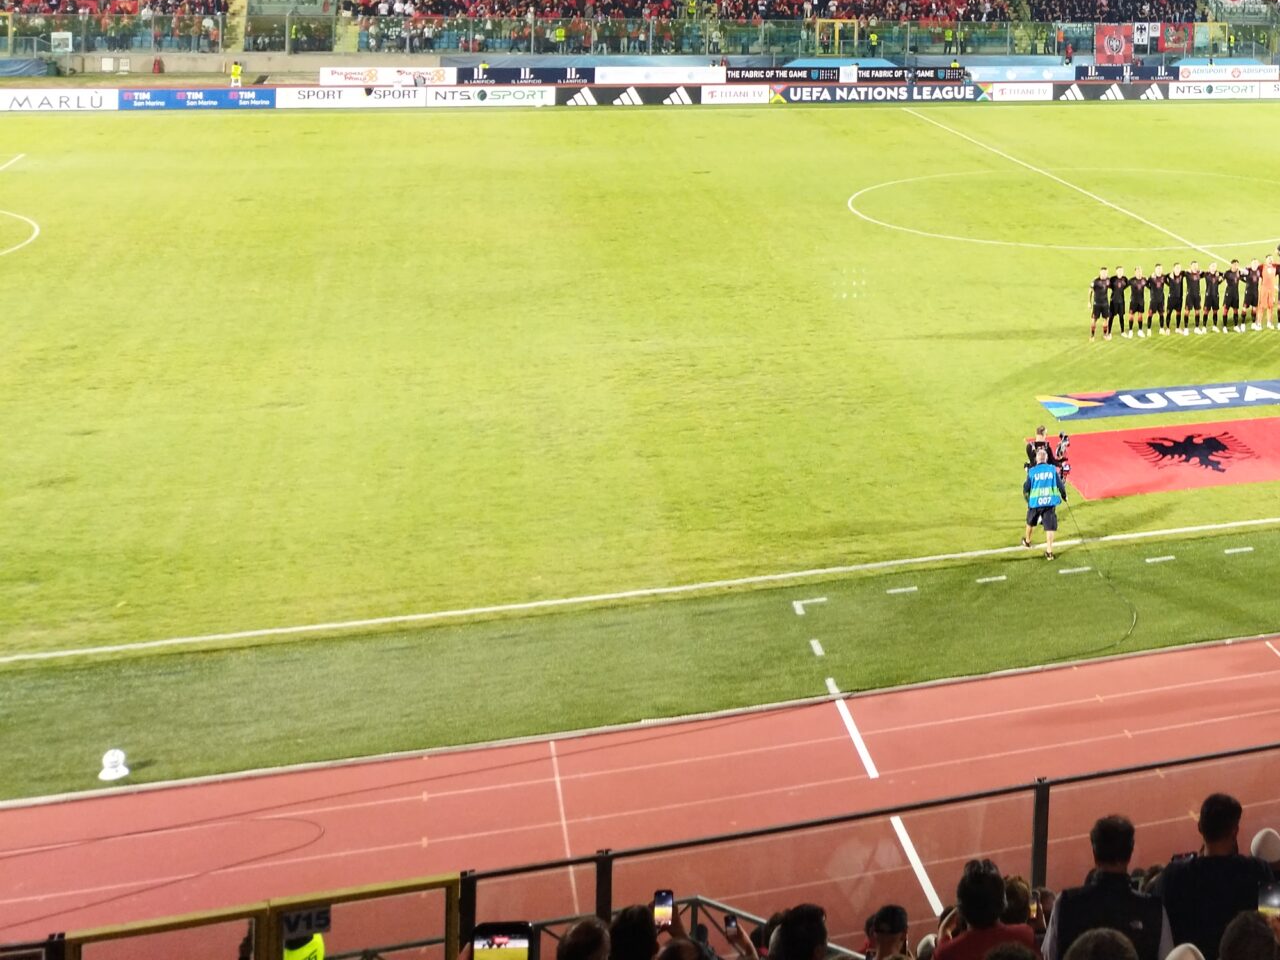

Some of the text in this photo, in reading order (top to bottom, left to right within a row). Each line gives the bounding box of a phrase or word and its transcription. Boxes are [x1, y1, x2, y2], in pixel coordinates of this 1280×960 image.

[727, 70, 807, 78] THE FABRIC OF THE GAME
[858, 70, 870, 78] THE
[871, 70, 893, 78] FABRIC
[894, 70, 903, 78] OF
[789, 85, 974, 101] UEFA NATIONS LEAGUE
[1214, 85, 1256, 93] SPORT
[9, 91, 103, 109] MARLÙ
[133, 92, 151, 100] TIM
[186, 92, 203, 100] TIM
[239, 91, 256, 99] TIM
[298, 90, 343, 100] SPORT
[374, 90, 419, 100] SPORT
[487, 90, 548, 100] SPORT
[1118, 386, 1276, 410] UEFA
[1034, 471, 1053, 481] UEFA
[1038, 497, 1052, 505] 007
[284, 910, 330, 933] V15
